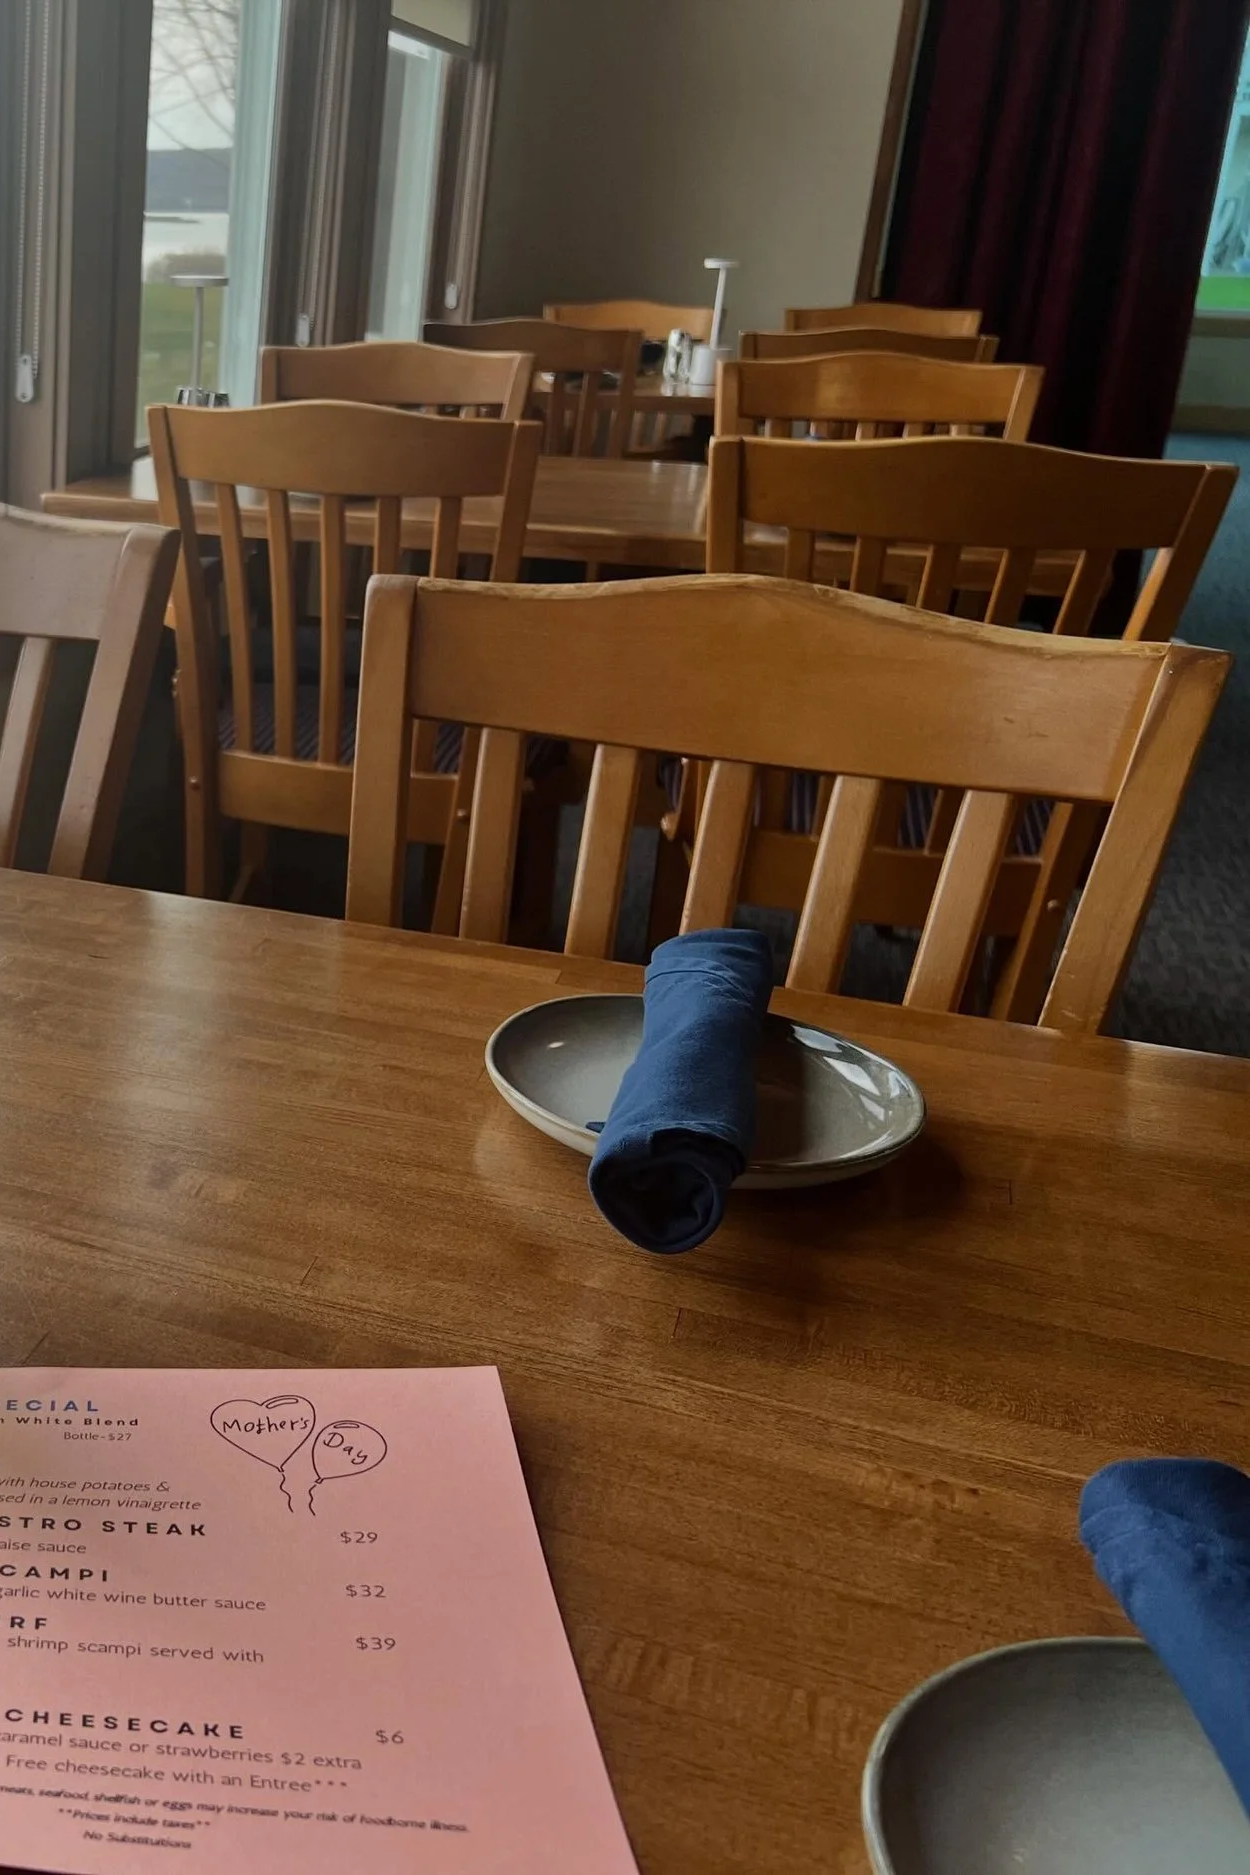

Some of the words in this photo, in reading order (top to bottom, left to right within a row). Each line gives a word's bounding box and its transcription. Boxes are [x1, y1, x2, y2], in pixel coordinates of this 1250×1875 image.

[16, 1416, 72, 1425] White
[84, 1418, 139, 1426] Blend
[223, 1416, 310, 1434] Mother's
[323, 1432, 367, 1464] Day
[30, 1478, 77, 1489] house
[81, 1480, 150, 1492] potatoes
[156, 1481, 171, 1492] &
[30, 1494, 43, 1504] in
[49, 1497, 59, 1505] a
[62, 1494, 111, 1507] lemon
[117, 1497, 202, 1511] vinaigrette
[101, 1520, 206, 1536] STEAK
[340, 1531, 378, 1544] $29
[37, 1542, 87, 1554] sauce
[345, 1584, 386, 1598] $32
[47, 1588, 97, 1602] white
[103, 1591, 147, 1605] wine
[153, 1592, 208, 1608] butter
[214, 1598, 266, 1611] sauce
[7, 1635, 68, 1653] shrimp
[77, 1640, 142, 1659] scampi
[150, 1645, 214, 1660] served
[222, 1649, 264, 1663] with
[355, 1636, 396, 1651] $39
[5, 1708, 243, 1739] CHEESECAKE
[376, 1729, 405, 1745] $6
[69, 1736, 122, 1752] sauce
[129, 1741, 149, 1753] or
[156, 1744, 273, 1764] strawberries
[281, 1752, 306, 1766] $2
[313, 1756, 362, 1770] extra
[6, 1754, 47, 1770] Free
[54, 1759, 165, 1781] cheesecake
[172, 1769, 214, 1785] with
[221, 1775, 242, 1787] an
[114, 1814, 158, 1827] include
[145, 1798, 158, 1807] or
[162, 1800, 192, 1811] eggs
[196, 1803, 223, 1814] may
[227, 1803, 279, 1818] increase
[284, 1810, 313, 1822] your
[316, 1811, 338, 1822] risk
[342, 1813, 357, 1824] of
[359, 1815, 426, 1831] foodborne
[83, 1831, 102, 1842] No
